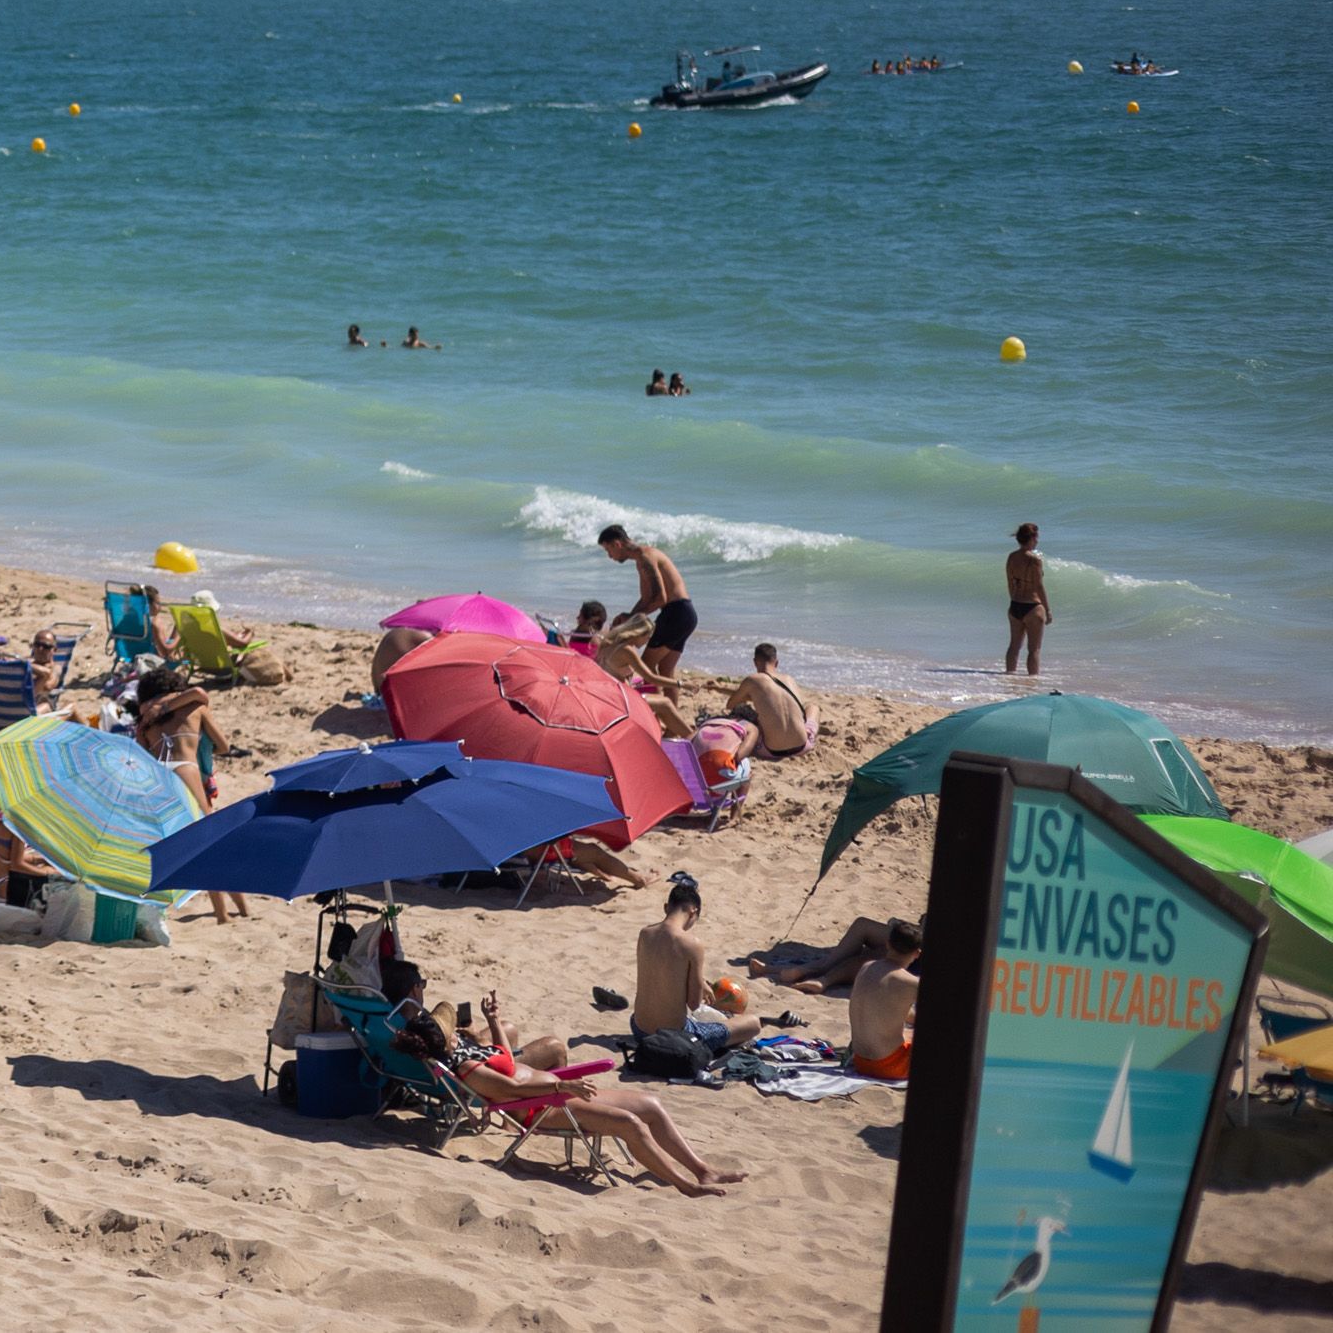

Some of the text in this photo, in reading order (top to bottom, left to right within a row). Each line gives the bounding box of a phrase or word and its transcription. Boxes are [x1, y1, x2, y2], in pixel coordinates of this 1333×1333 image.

[1007, 805, 1086, 881] USA
[998, 880, 1179, 966] ENVASES
[989, 958, 1224, 1033] REUTILIZABLES
